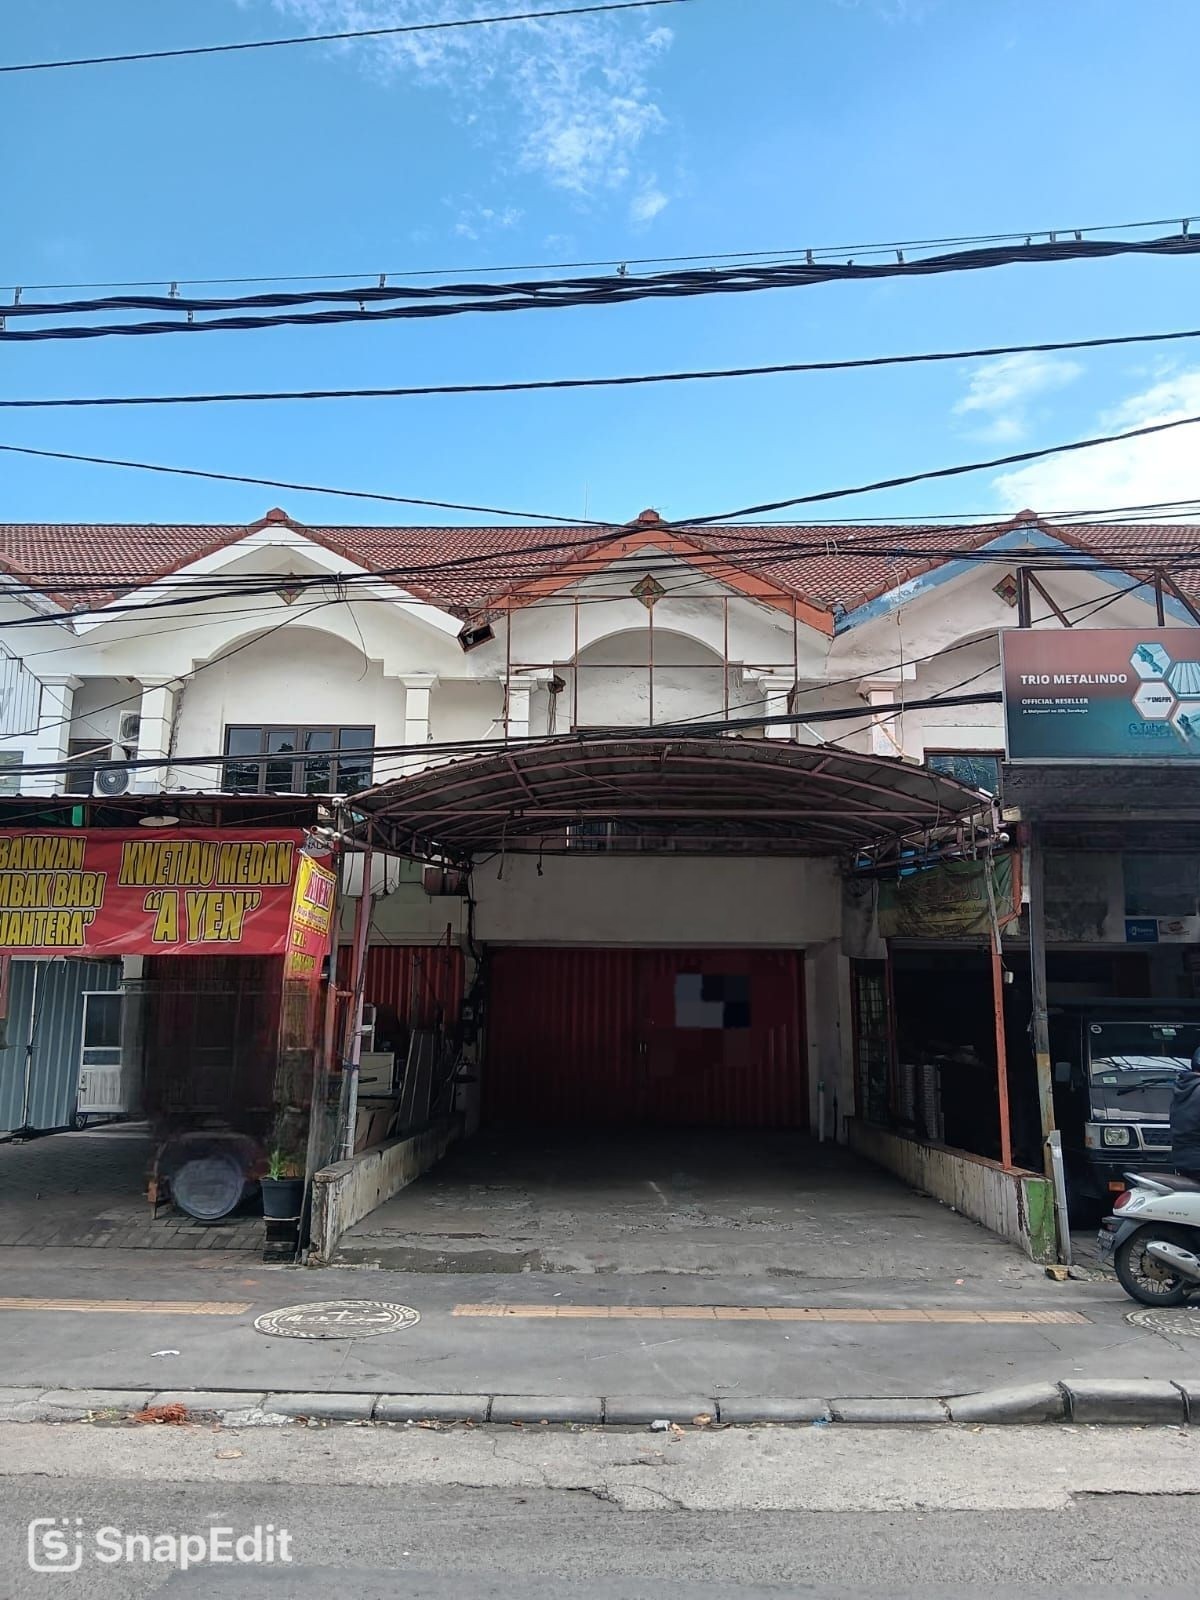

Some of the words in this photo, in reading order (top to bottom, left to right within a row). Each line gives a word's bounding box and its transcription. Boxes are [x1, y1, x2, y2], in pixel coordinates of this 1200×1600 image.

[1020, 674, 1050, 685] TRIO
[1053, 673, 1128, 684] METALINDO
[118, 840, 219, 887] KWETIAU
[215, 840, 295, 887] MEDAN
[51, 872, 107, 909] BABI
